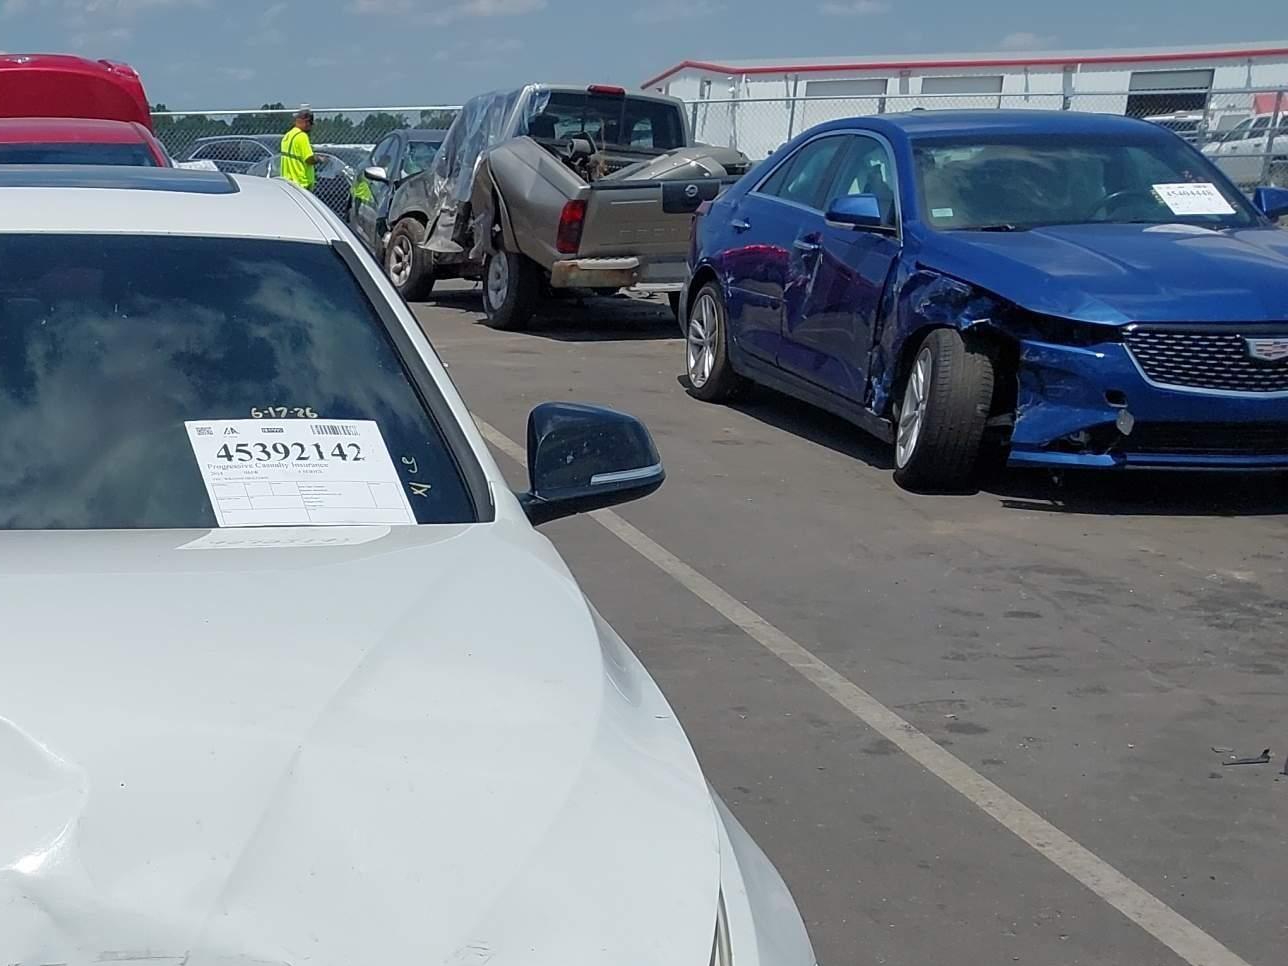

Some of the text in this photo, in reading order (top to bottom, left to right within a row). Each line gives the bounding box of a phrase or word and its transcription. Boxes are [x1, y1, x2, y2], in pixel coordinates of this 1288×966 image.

[250, 406, 319, 419] 6-17-26
[216, 442, 365, 462] 45392142
[207, 463, 254, 471] Progressive
[291, 461, 329, 469] Insurance
